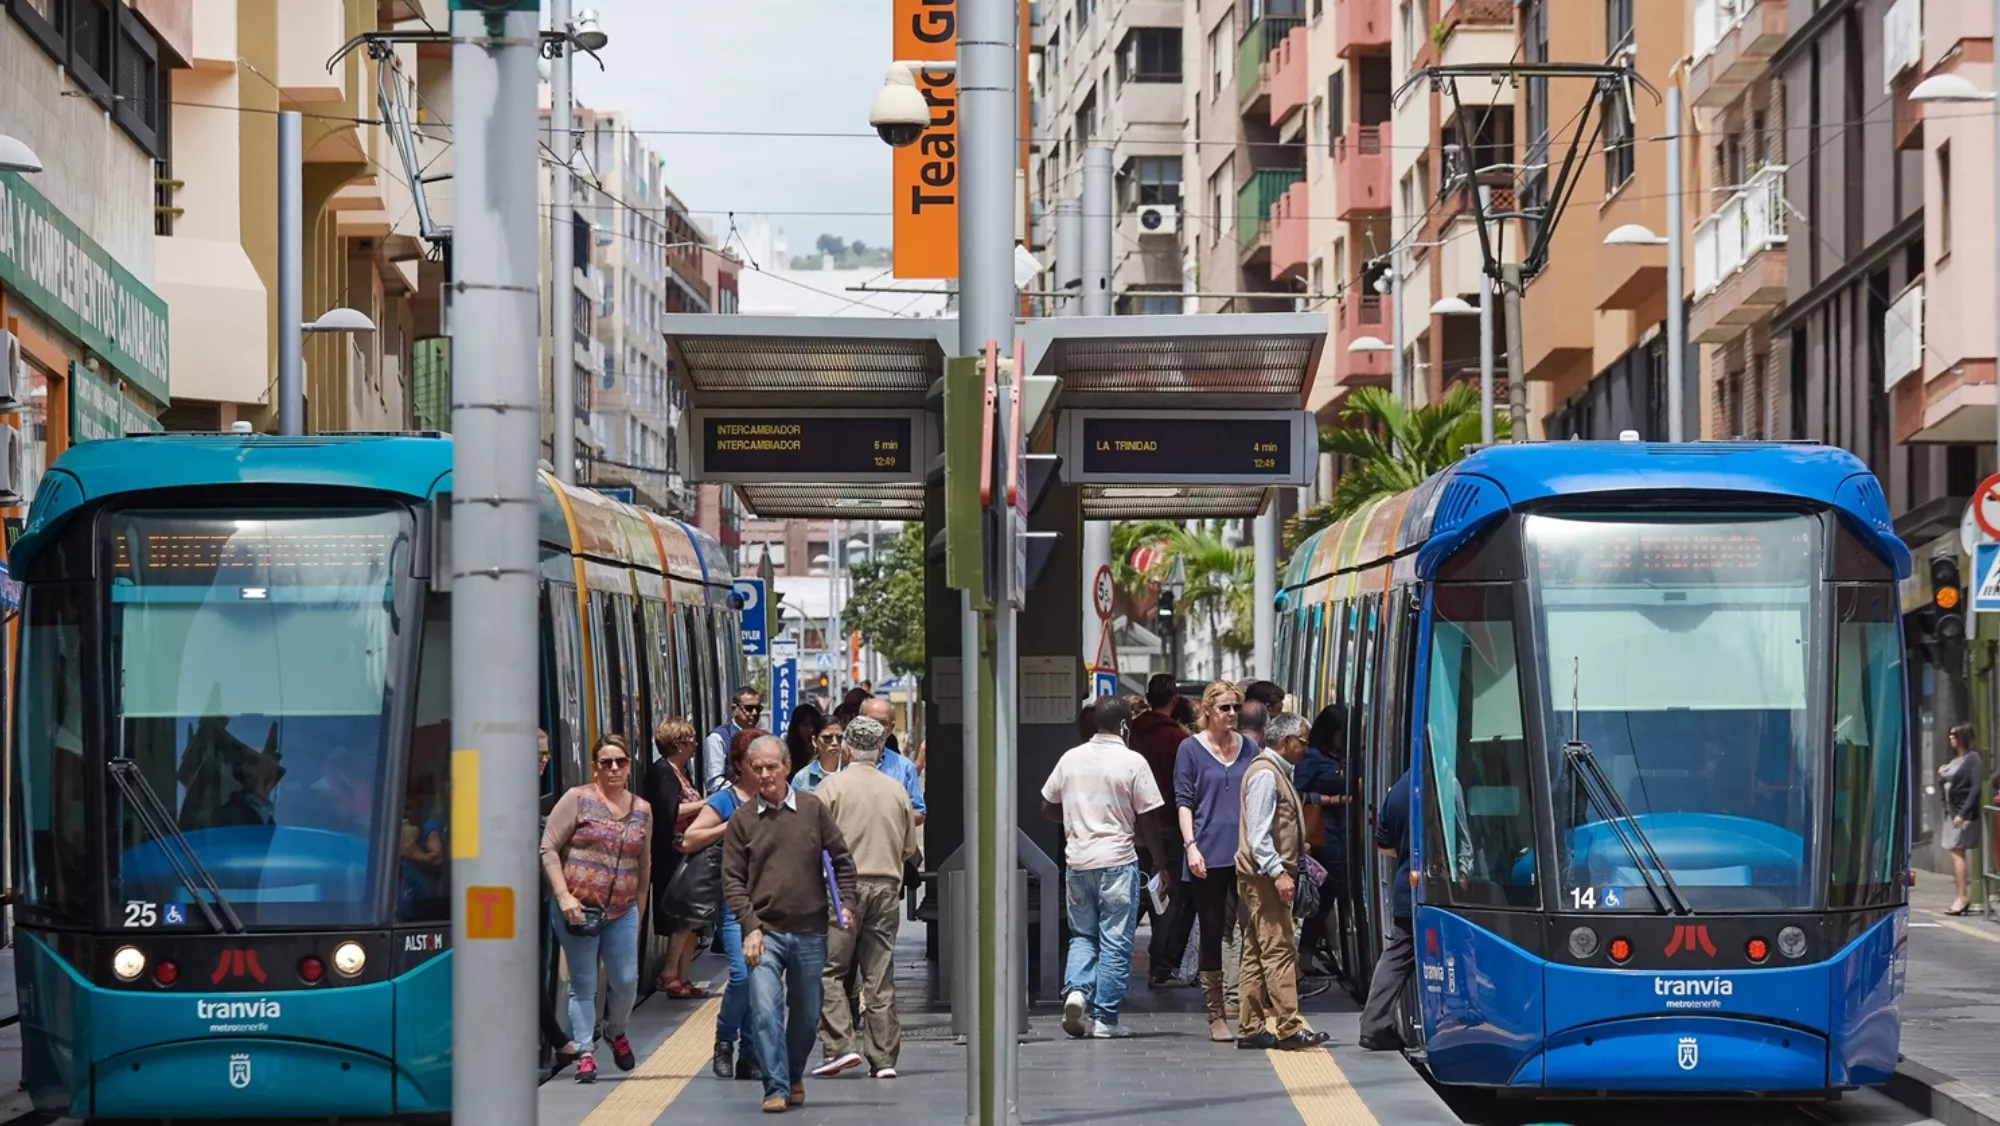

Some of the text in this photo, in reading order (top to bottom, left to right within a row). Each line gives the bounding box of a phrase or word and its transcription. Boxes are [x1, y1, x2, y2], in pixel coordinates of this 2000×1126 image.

[17, 197, 27, 272] Y
[29, 208, 116, 340] COMPLEMENTOS
[118, 285, 167, 383] CANARIAS
[717, 425, 801, 435] INTERCAMBIADOR
[717, 440, 801, 450] INTERCAMBIADOR
[882, 440, 899, 450] min
[1096, 441, 1278, 452] LA TRINIDAD 4 min
[1254, 459, 1276, 468] 12:49
[1570, 887, 1597, 909] 14
[124, 904, 158, 928] 25
[475, 892, 502, 930] T
[404, 932, 443, 952] ALSTOM
[1654, 976, 1733, 995] tranvía
[197, 998, 281, 1019] tranvía
[1666, 1000, 1722, 1009] metrotenerife
